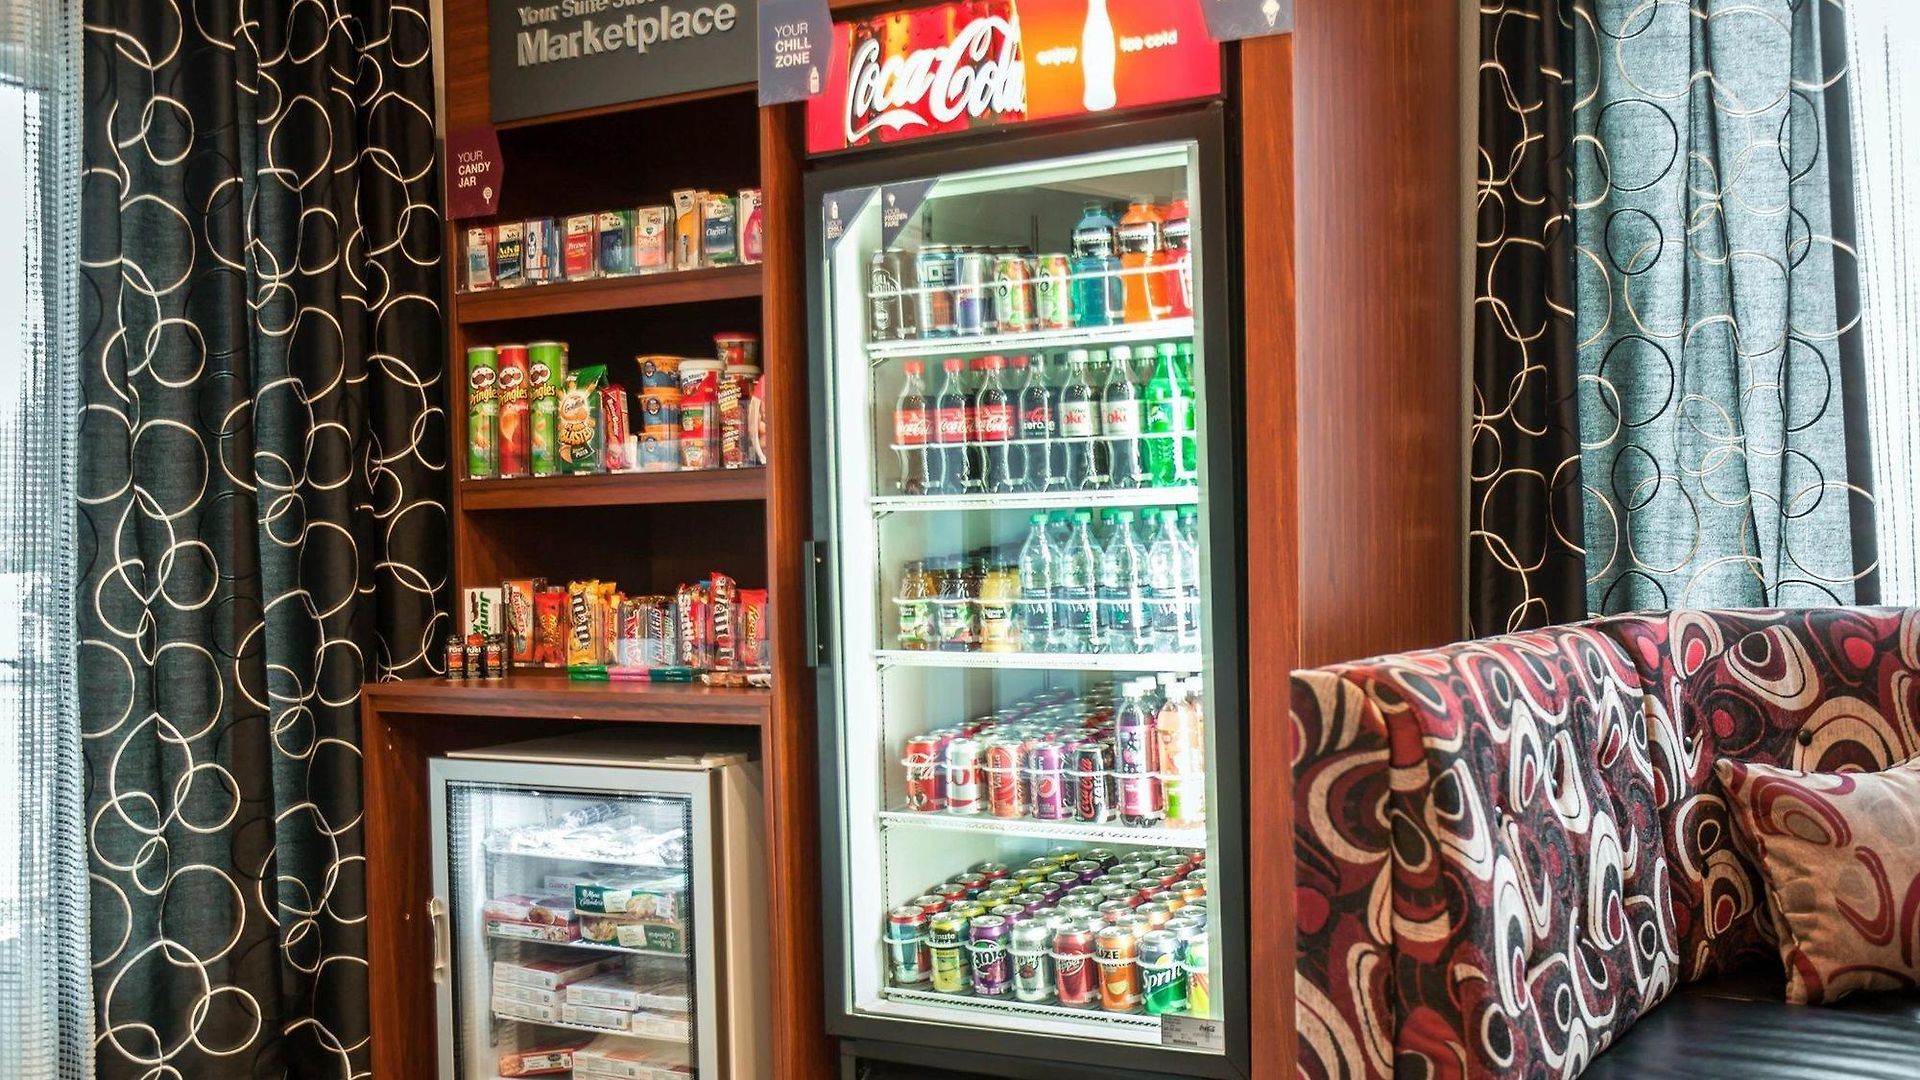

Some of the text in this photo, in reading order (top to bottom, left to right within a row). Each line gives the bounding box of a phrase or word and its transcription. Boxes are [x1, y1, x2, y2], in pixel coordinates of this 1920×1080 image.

[517, 6, 559, 26] Your
[774, 22, 809, 38] YOUR
[516, 3, 737, 67] Marketplace
[775, 37, 812, 53] CHILL
[1036, 46, 1077, 67] enjoy
[1144, 28, 1179, 50] cold
[775, 51, 810, 69] ZONE
[848, 15, 1027, 143] Coca-Cola
[457, 150, 484, 163] YOUR
[458, 161, 491, 176] CANDY
[458, 176, 477, 188] JAR
[478, 592, 492, 640] Junio
[677, 593, 695, 662] Skittles
[1080, 757, 1096, 819] Coca-Cola
[1094, 770, 1104, 806] zero
